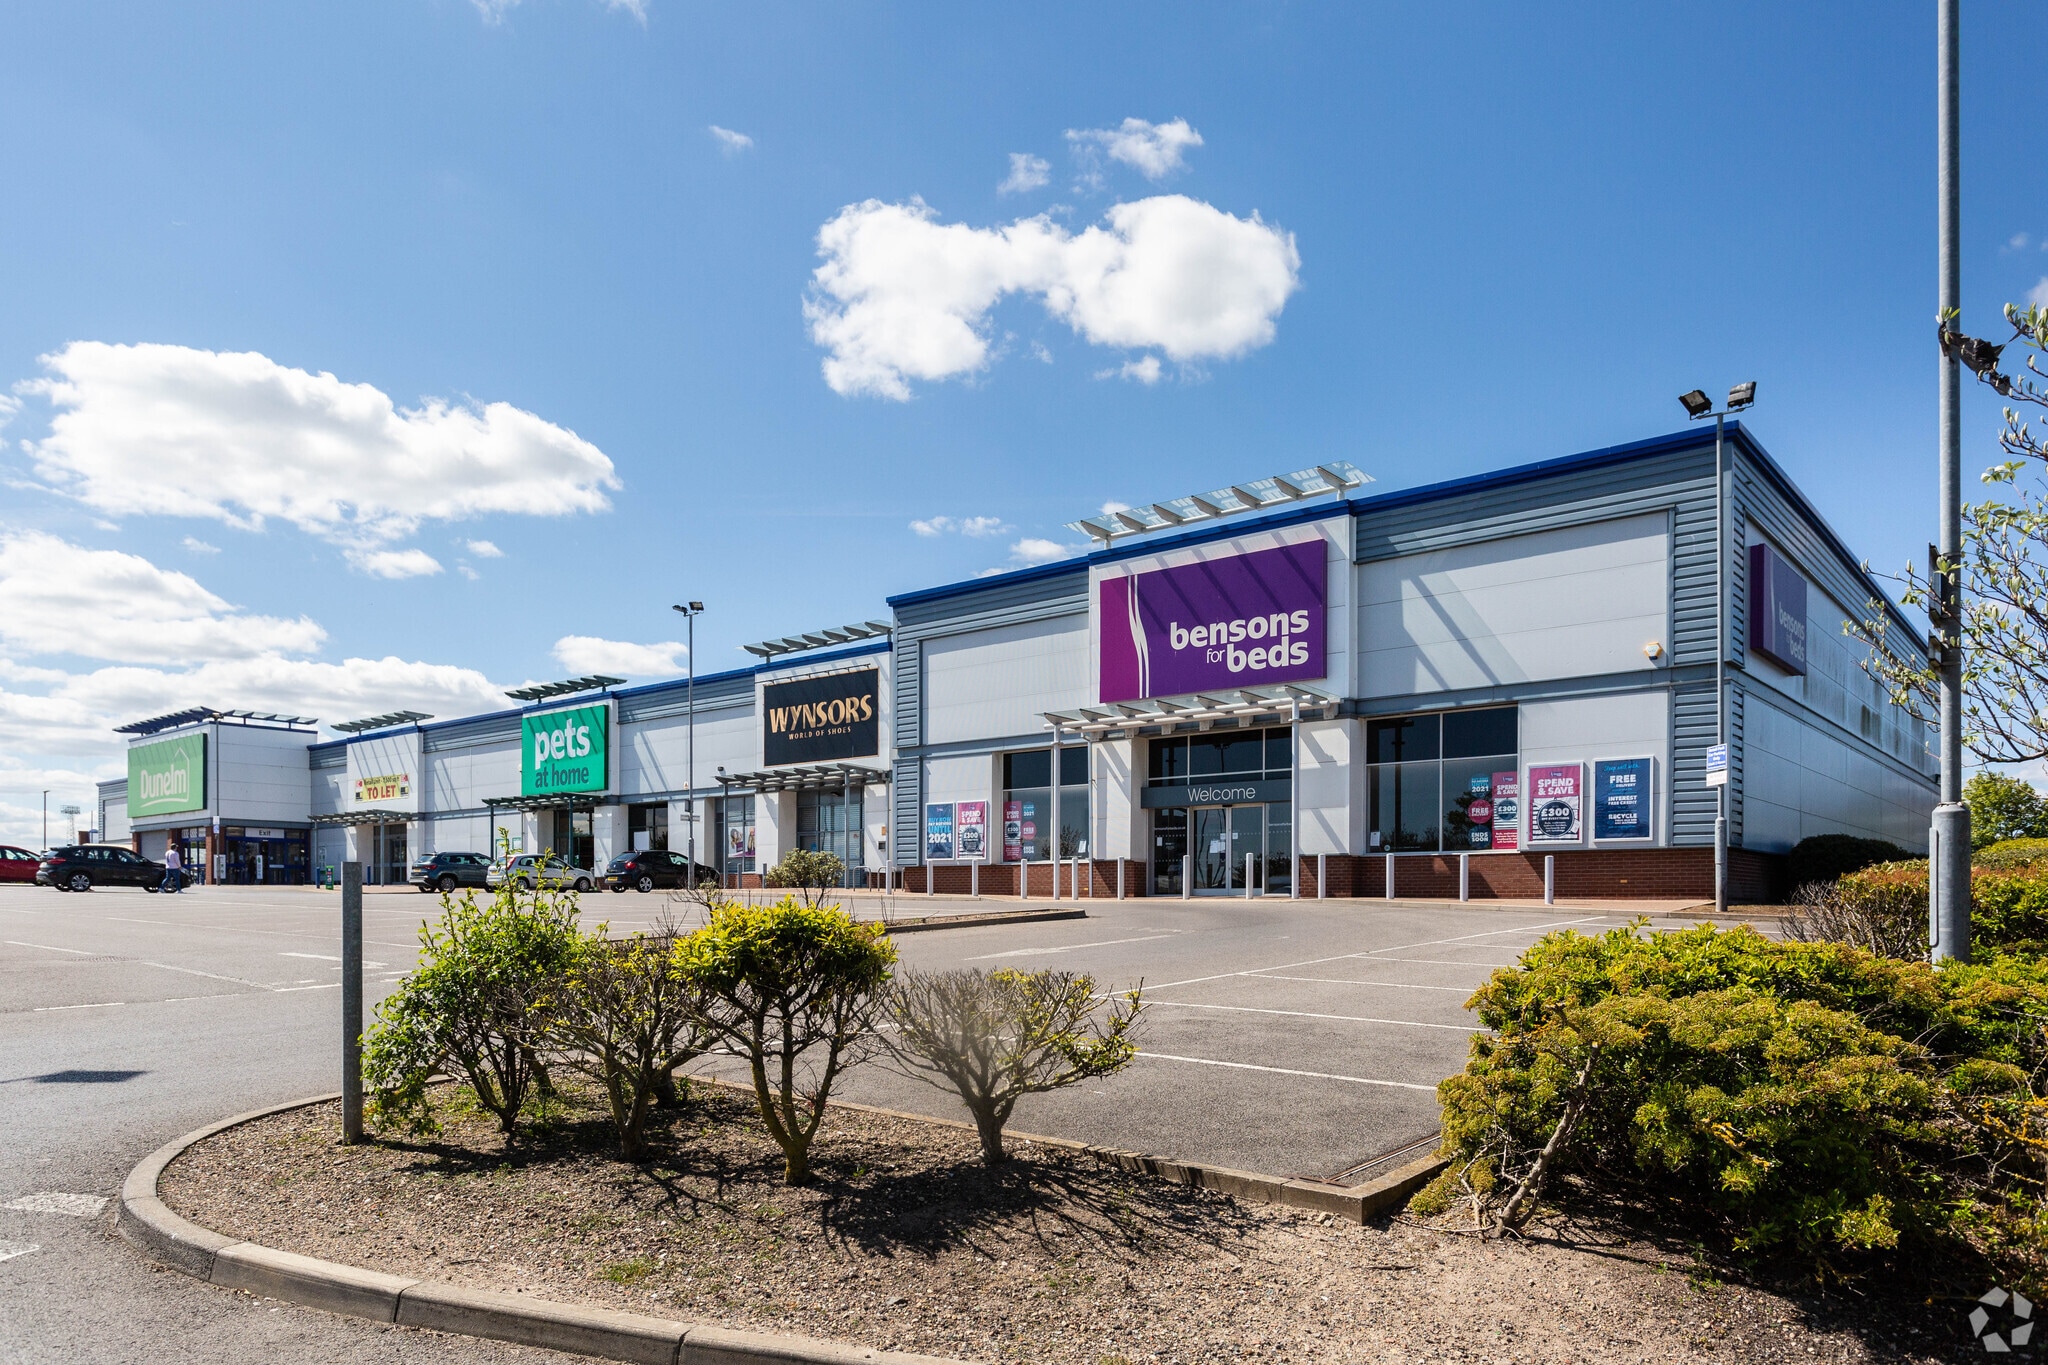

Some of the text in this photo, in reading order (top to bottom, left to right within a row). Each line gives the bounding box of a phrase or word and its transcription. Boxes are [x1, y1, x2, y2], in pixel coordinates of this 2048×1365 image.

[1778, 601, 1805, 641] bensons
[1170, 609, 1310, 650] bensons
[1206, 636, 1309, 673] for beds
[1789, 634, 1805, 662] beds
[769, 694, 873, 733] WYNSORS
[788, 731, 813, 740] WORLD
[827, 726, 852, 736] SHOES
[534, 718, 591, 770] pets
[140, 763, 187, 799] Dunelm
[535, 763, 590, 789] at home
[1538, 778, 1574, 788] SPEND
[1609, 774, 1636, 784] FREE
[367, 786, 379, 800] TO
[380, 784, 396, 798] LET
[1188, 787, 1256, 802] Welcome
[1548, 786, 1574, 795] SAVE
[961, 810, 981, 818] SPEND
[1541, 807, 1570, 817] £300
[258, 829, 271, 837] Exit
[928, 825, 952, 834] UNTIL
[928, 833, 952, 844] 2021
